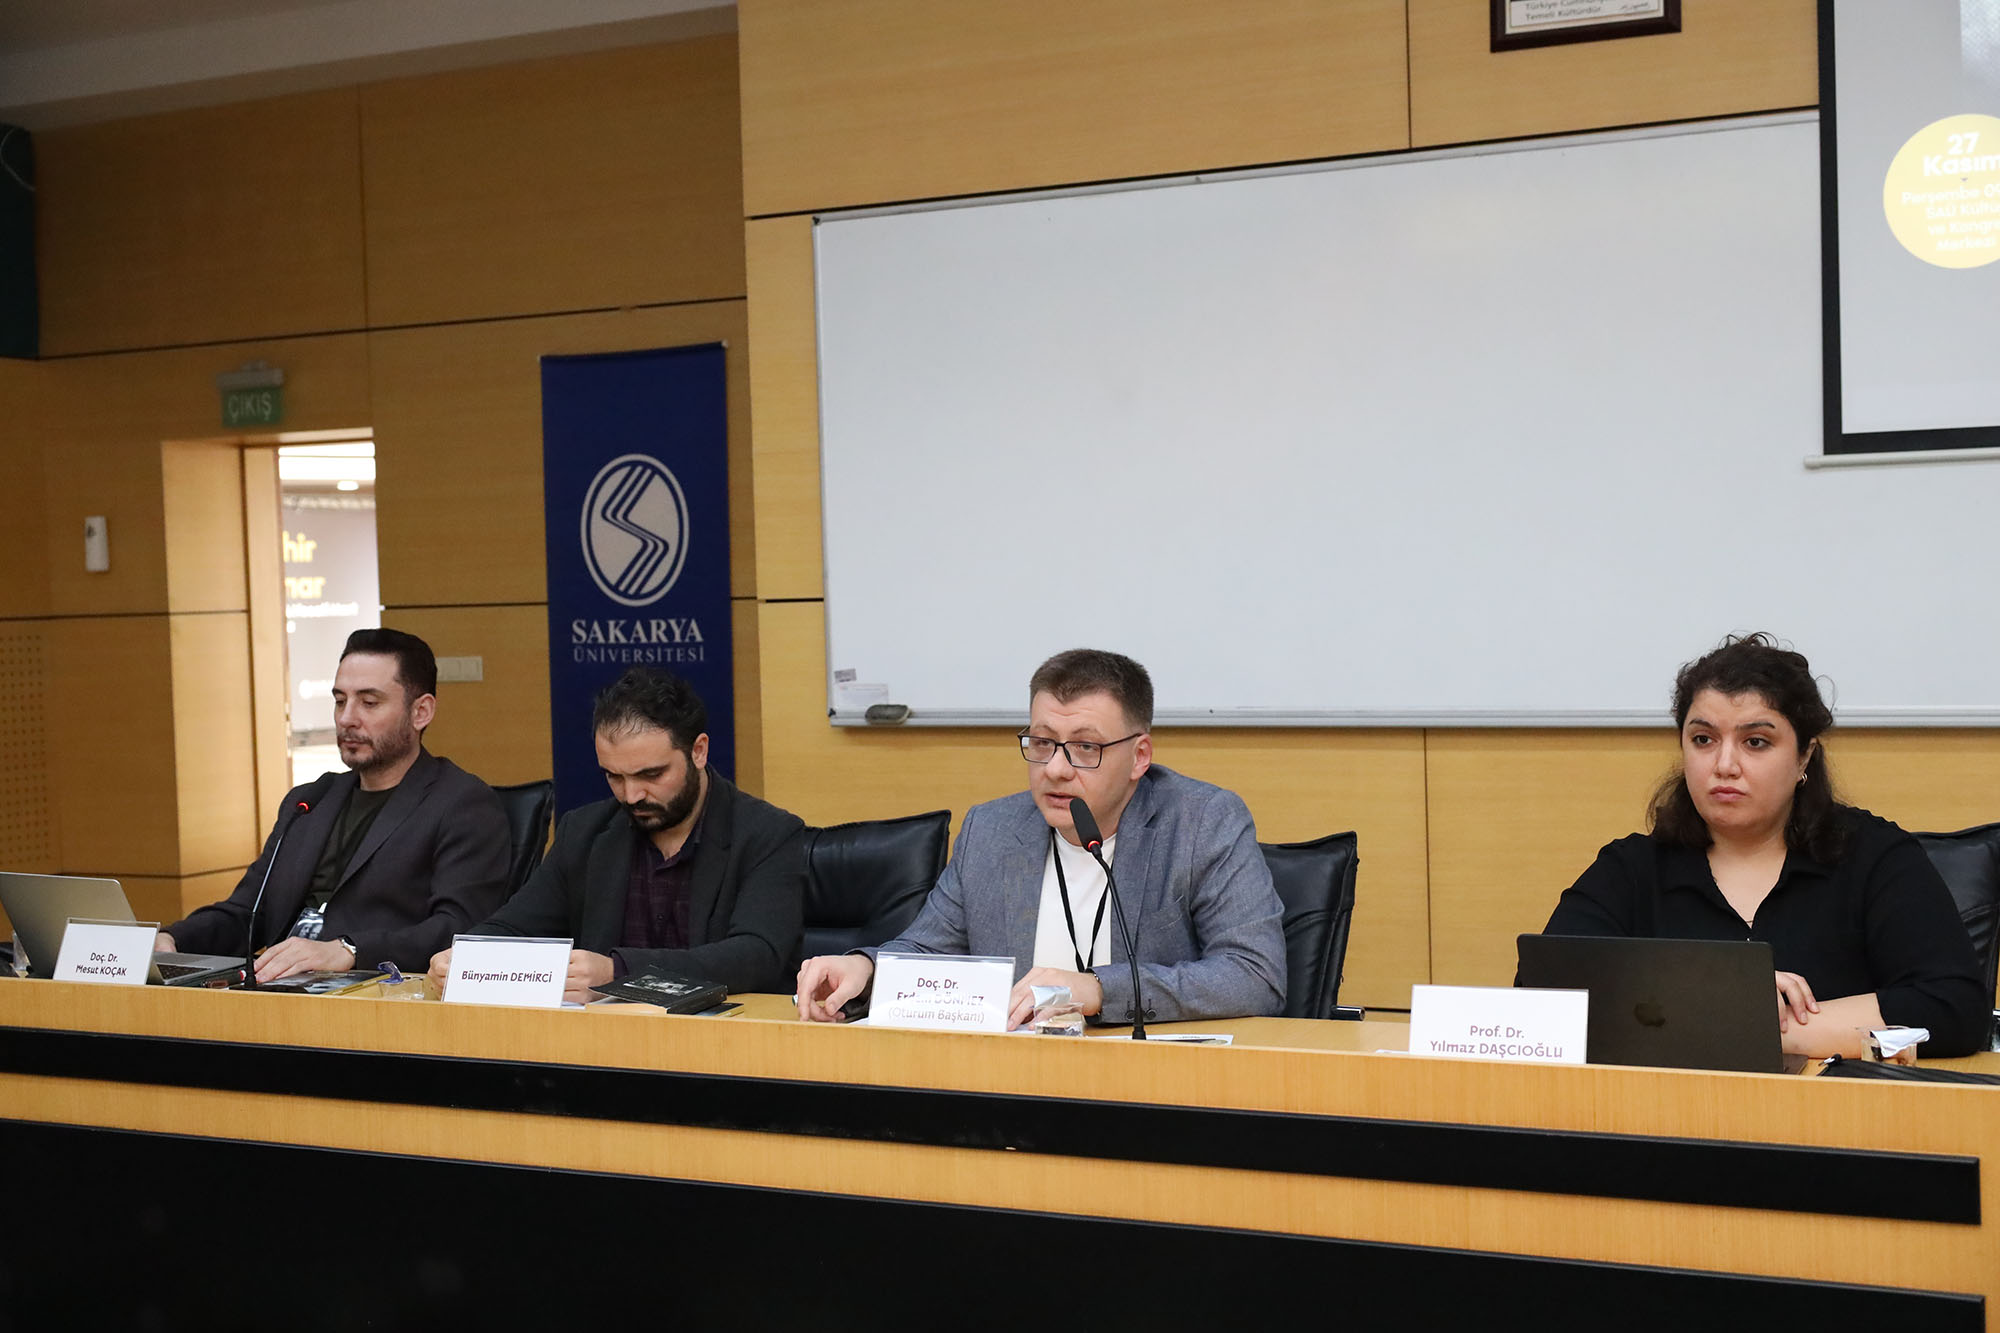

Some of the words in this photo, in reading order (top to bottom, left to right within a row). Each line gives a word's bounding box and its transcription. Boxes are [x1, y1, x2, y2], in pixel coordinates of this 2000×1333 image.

[1947, 132, 1980, 155] 27
[1923, 154, 2000, 177] Kasım
[228, 391, 273, 424] ÇIKIŞ
[571, 618, 705, 644] SAKARYA
[573, 645, 705, 663] ÜNİVERSİTESİ
[90, 952, 106, 963] Doç.
[107, 953, 118, 962] Dr.
[76, 964, 99, 974] Mesut
[99, 966, 127, 977] KOÇAK
[461, 970, 508, 983] Bünyamin
[510, 971, 553, 983] DEMİRCİ
[917, 977, 941, 991] Doç.
[943, 978, 959, 989] Dr.
[888, 1007, 935, 1020] (Oturum
[937, 1009, 985, 1024] Başkanı)
[1470, 1025, 1502, 1038] Prof.
[1505, 1026, 1525, 1039] Dr.
[1430, 1040, 1475, 1054] Yılmaz
[1479, 1042, 1563, 1058] DAŞCIOĞLU
